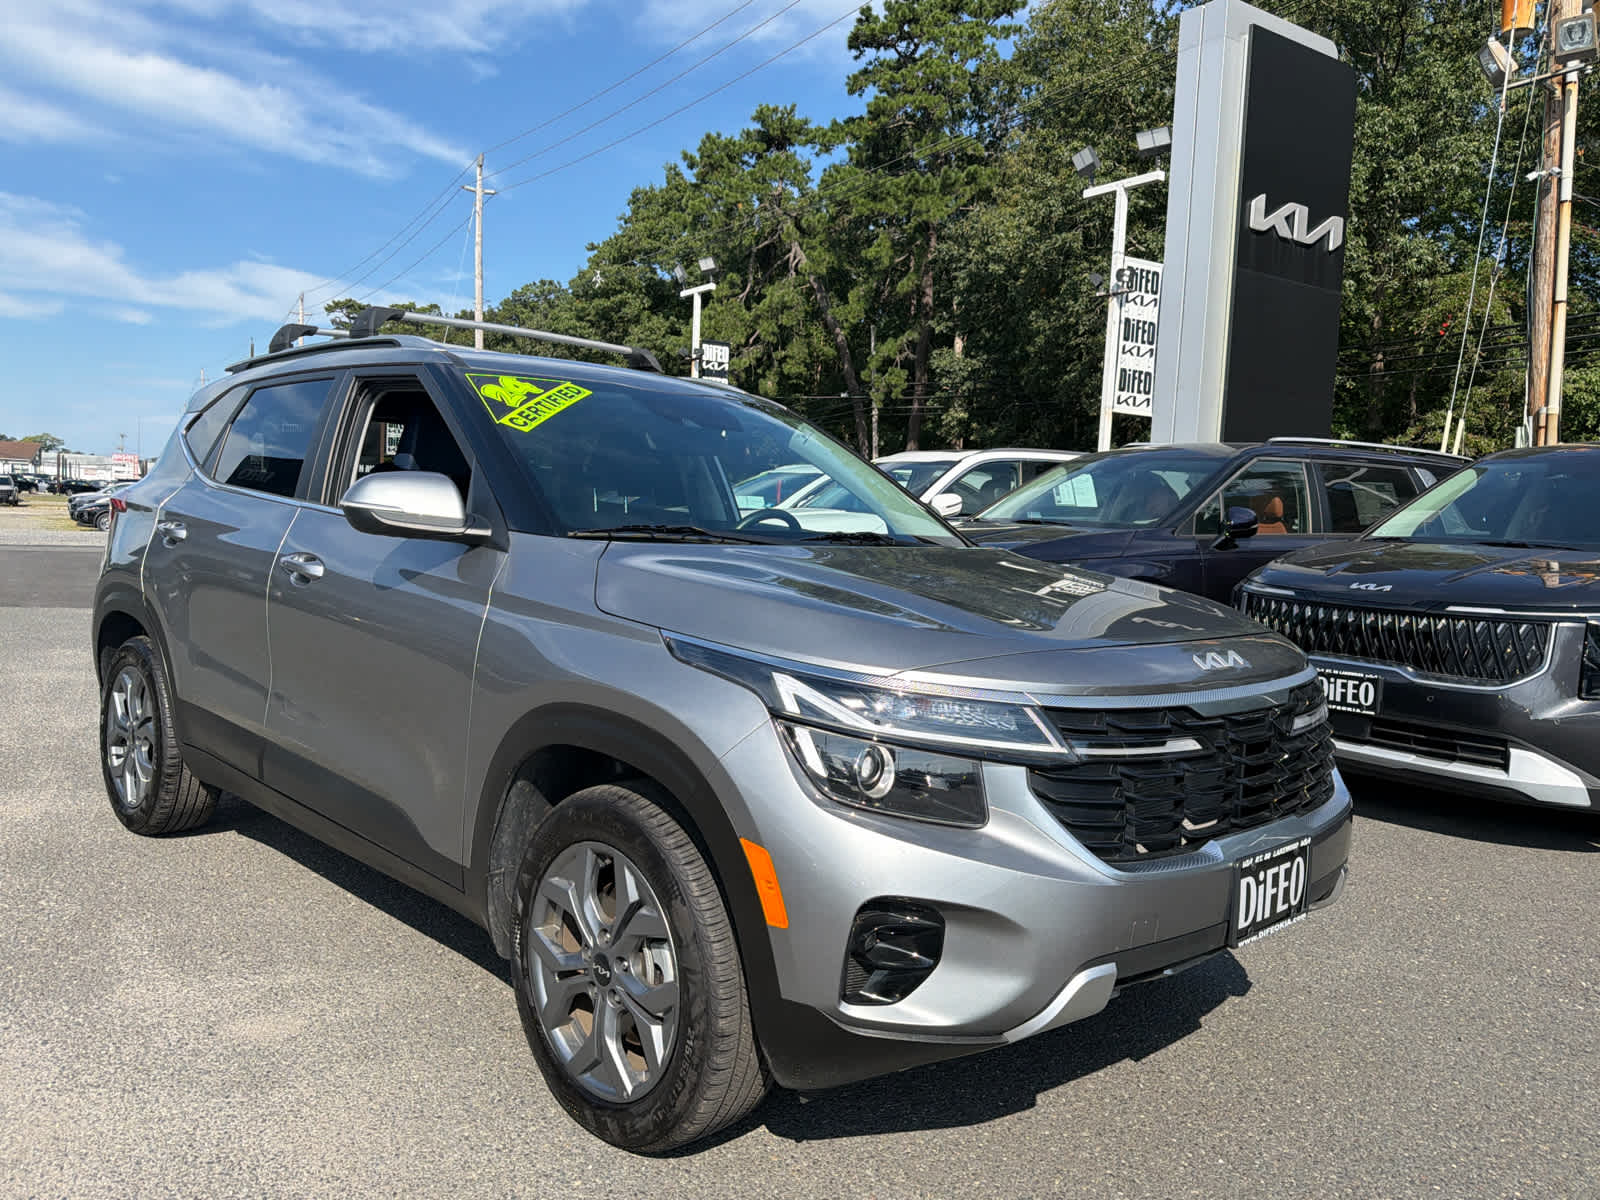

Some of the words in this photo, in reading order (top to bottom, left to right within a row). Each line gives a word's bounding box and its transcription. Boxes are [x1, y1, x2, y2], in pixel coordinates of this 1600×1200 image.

[1250, 193, 1344, 251] KIA
[1125, 294, 1158, 307] KIA
[1122, 317, 1156, 345] DiFEO
[1121, 345, 1154, 358] KIA
[481, 376, 544, 408] 24
[1118, 368, 1152, 395] DiFEO
[508, 386, 582, 427] CERTIFIED
[1116, 395, 1151, 408] KIA
[1192, 650, 1244, 670] KIA
[1318, 676, 1375, 706] DiFEO
[1238, 857, 1304, 930] DiFEO
